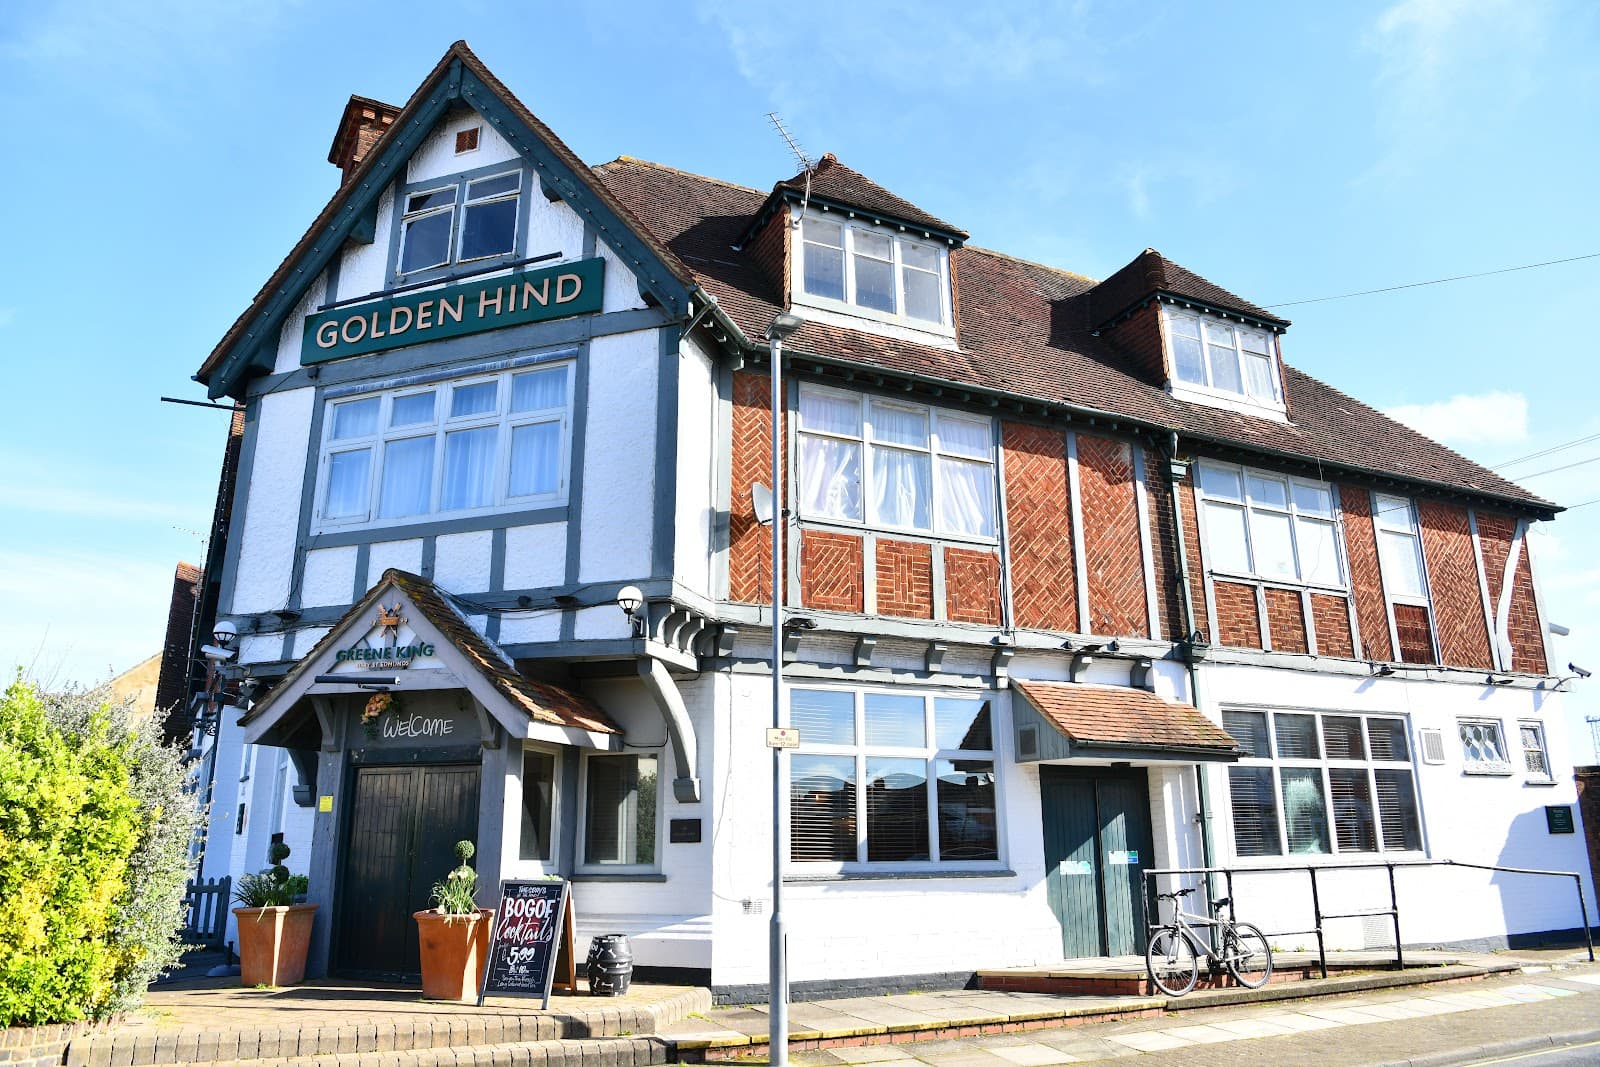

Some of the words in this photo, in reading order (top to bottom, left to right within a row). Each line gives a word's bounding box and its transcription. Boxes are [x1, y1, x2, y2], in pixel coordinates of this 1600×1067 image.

[316, 294, 464, 348] GOLDEN
[478, 273, 583, 318] HIND
[335, 647, 391, 662] GREENE
[396, 641, 435, 659] KING
[383, 713, 453, 738] WELCOME
[496, 917, 553, 944] Cocktails
